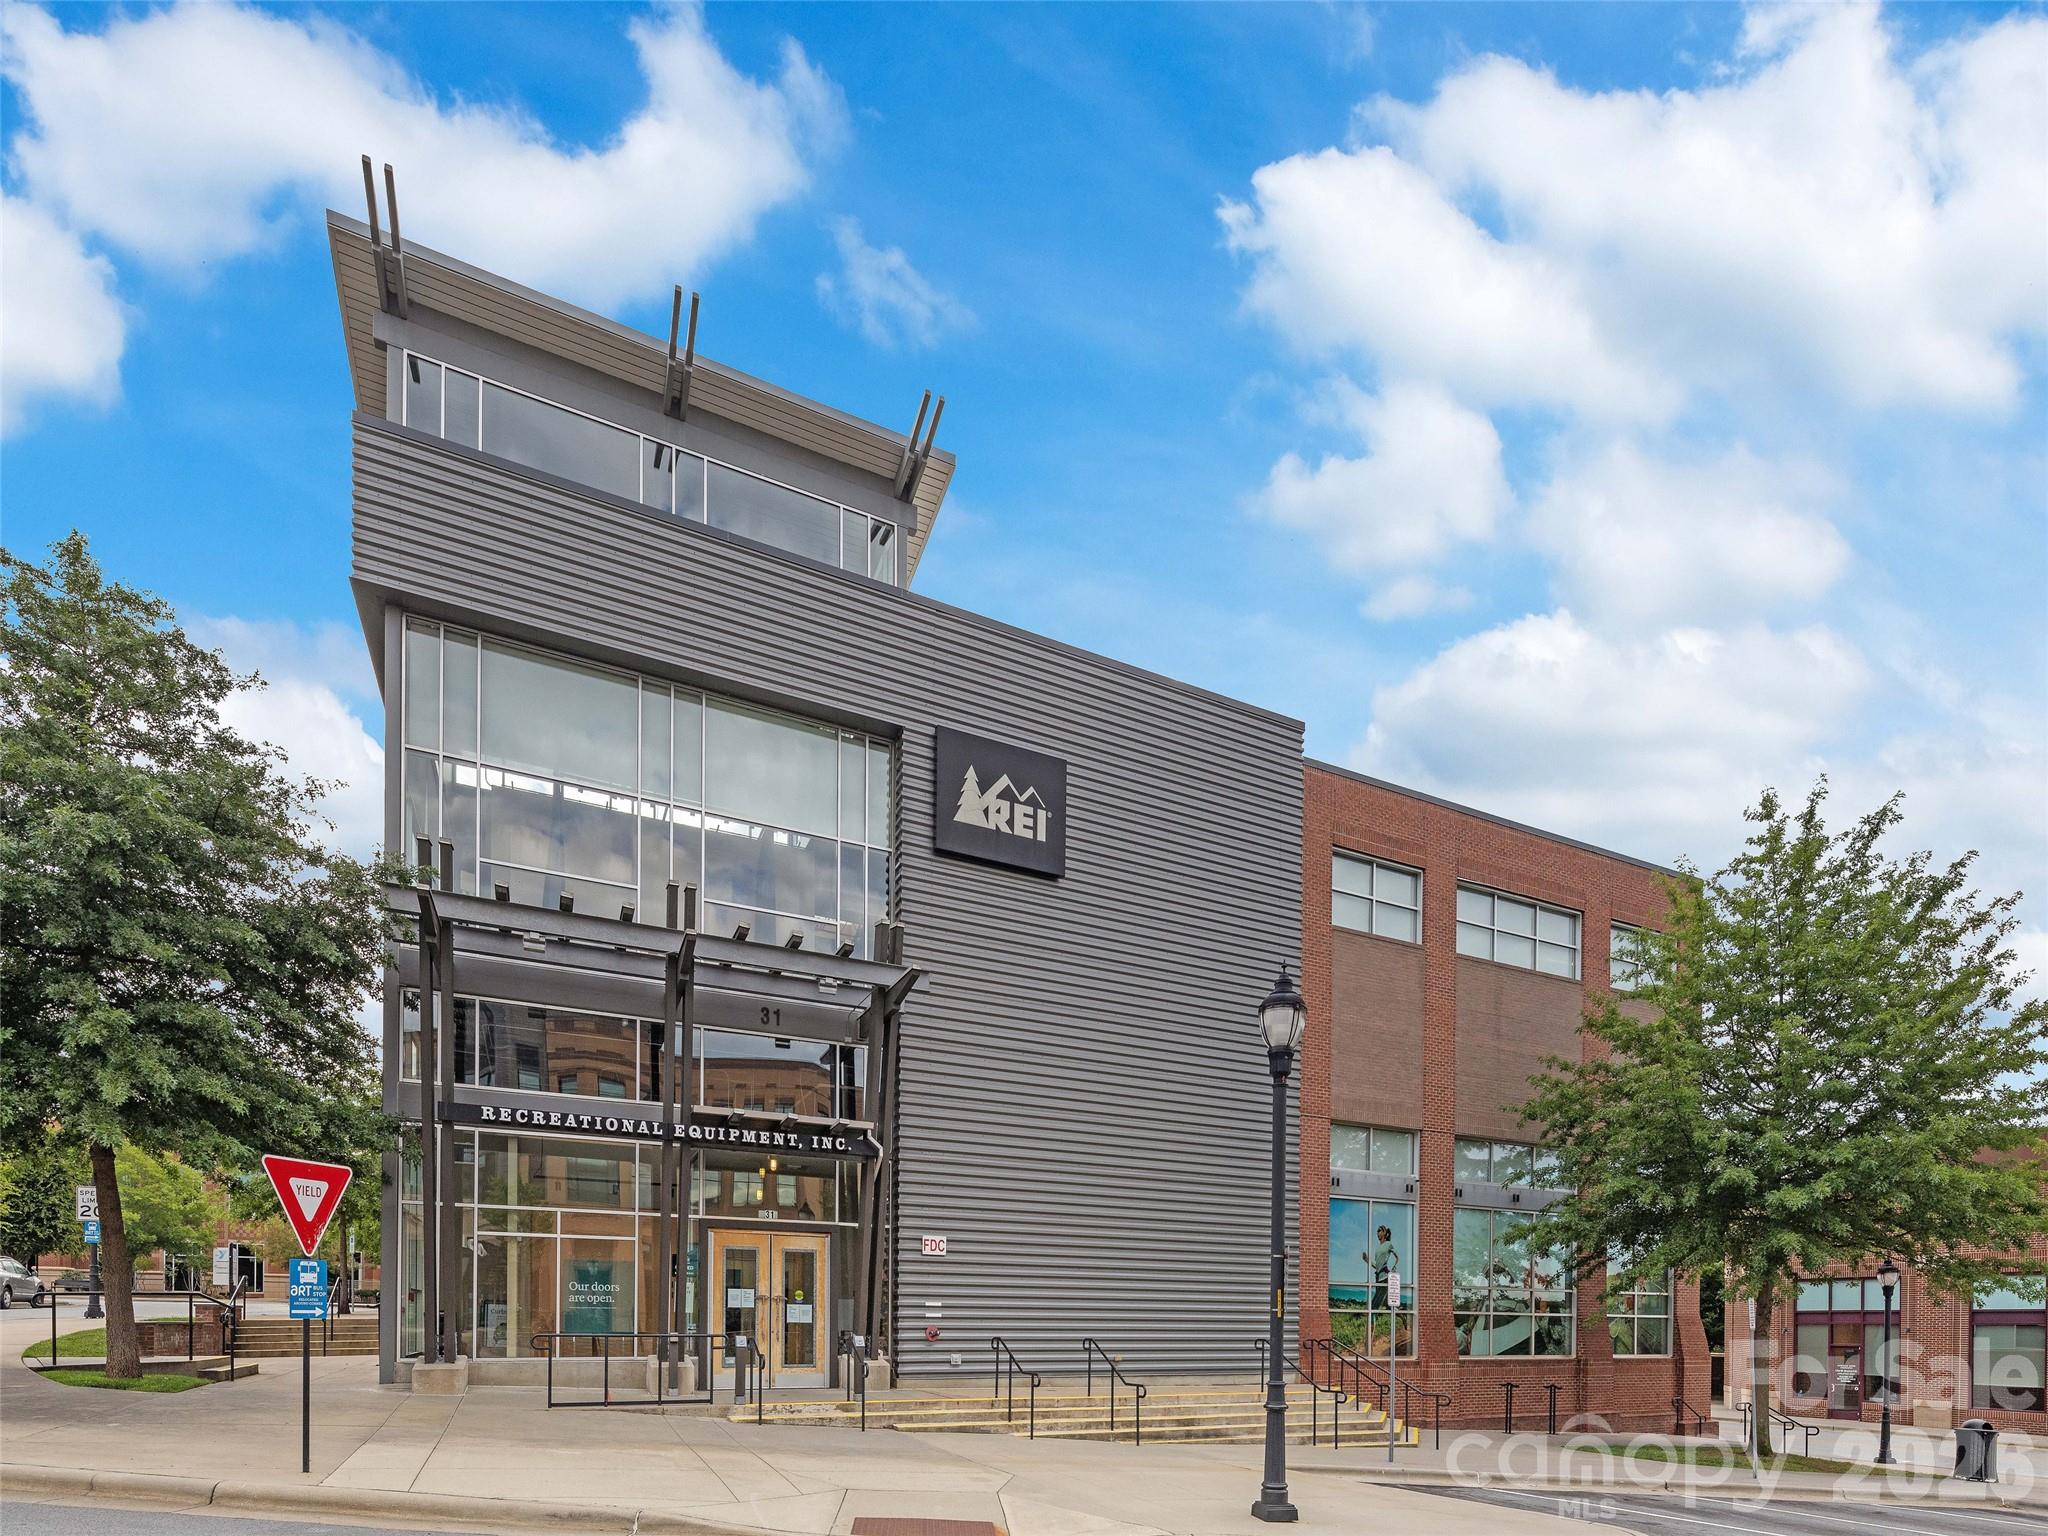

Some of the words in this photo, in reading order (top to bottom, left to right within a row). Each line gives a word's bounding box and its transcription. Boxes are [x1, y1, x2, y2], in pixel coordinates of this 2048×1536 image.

[988, 798, 1046, 842] REI
[761, 1007, 780, 1026] 31
[481, 1106, 663, 1136] RECREATIONAL
[673, 1124, 803, 1149] EQUIPMENT,
[812, 1136, 852, 1150] INC.
[296, 1184, 322, 1198] YIELD
[765, 1210, 774, 1219] 31
[923, 1238, 945, 1252] FDC
[568, 1281, 589, 1291] Our
[591, 1281, 620, 1292] doors
[568, 1294, 585, 1302] are
[587, 1294, 615, 1305] open.
